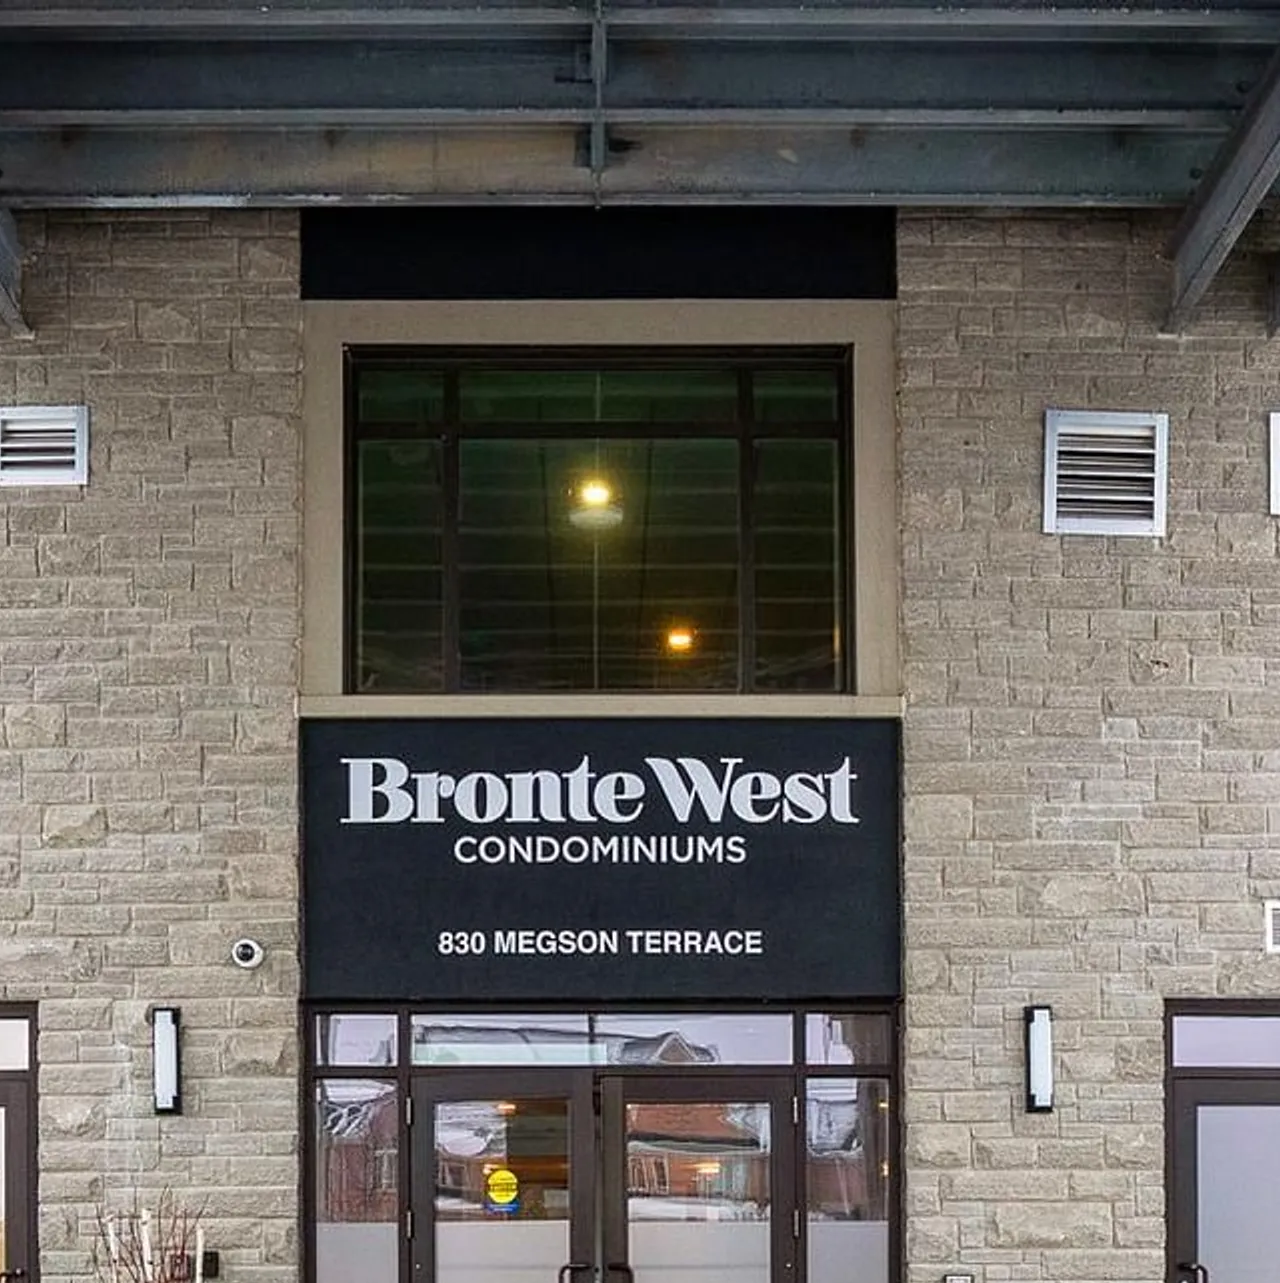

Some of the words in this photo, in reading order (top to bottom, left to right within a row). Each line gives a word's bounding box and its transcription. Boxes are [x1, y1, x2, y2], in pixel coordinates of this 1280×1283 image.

[339, 755, 644, 824] Bronte
[644, 756, 860, 824] West
[453, 835, 747, 864] CONDOMINIUMS
[437, 929, 486, 955] 830
[493, 929, 619, 955] MEGSON
[624, 929, 763, 955] TERRACE
